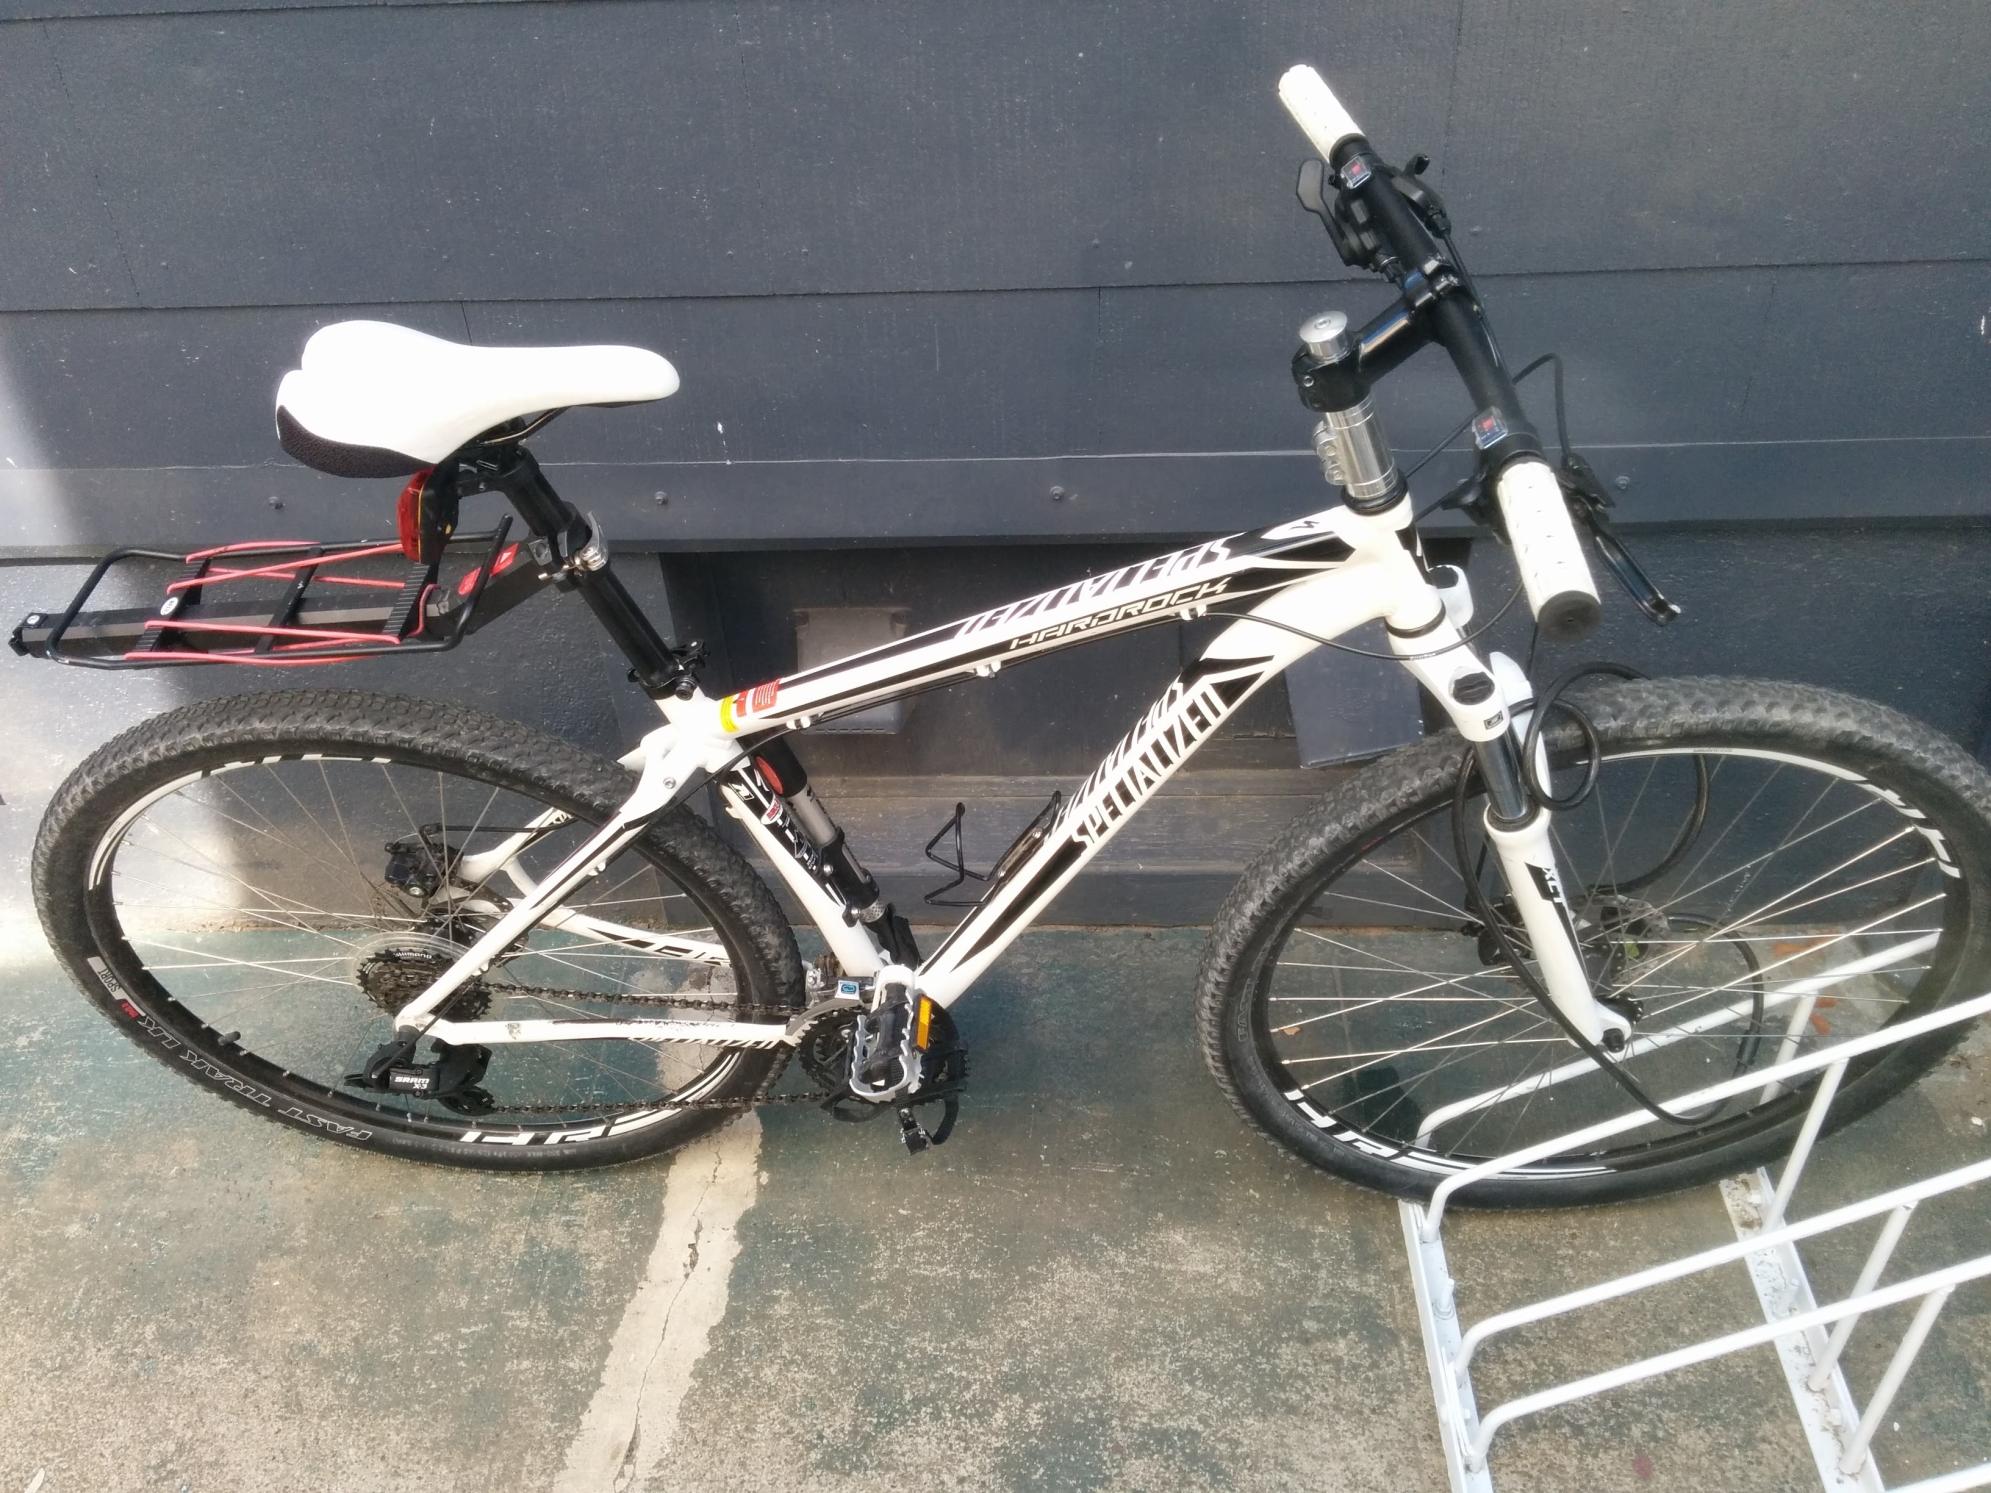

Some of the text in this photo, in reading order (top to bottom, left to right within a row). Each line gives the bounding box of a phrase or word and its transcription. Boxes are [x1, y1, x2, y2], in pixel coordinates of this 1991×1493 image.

[1010, 576, 1232, 650] HARDROCK
[1071, 683, 1230, 850] SPECIALIZED
[99, 967, 121, 993] SPORT
[180, 1049, 272, 1108] TRAK
[394, 1075, 431, 1085] SRAM
[278, 1106, 373, 1142] FAST
